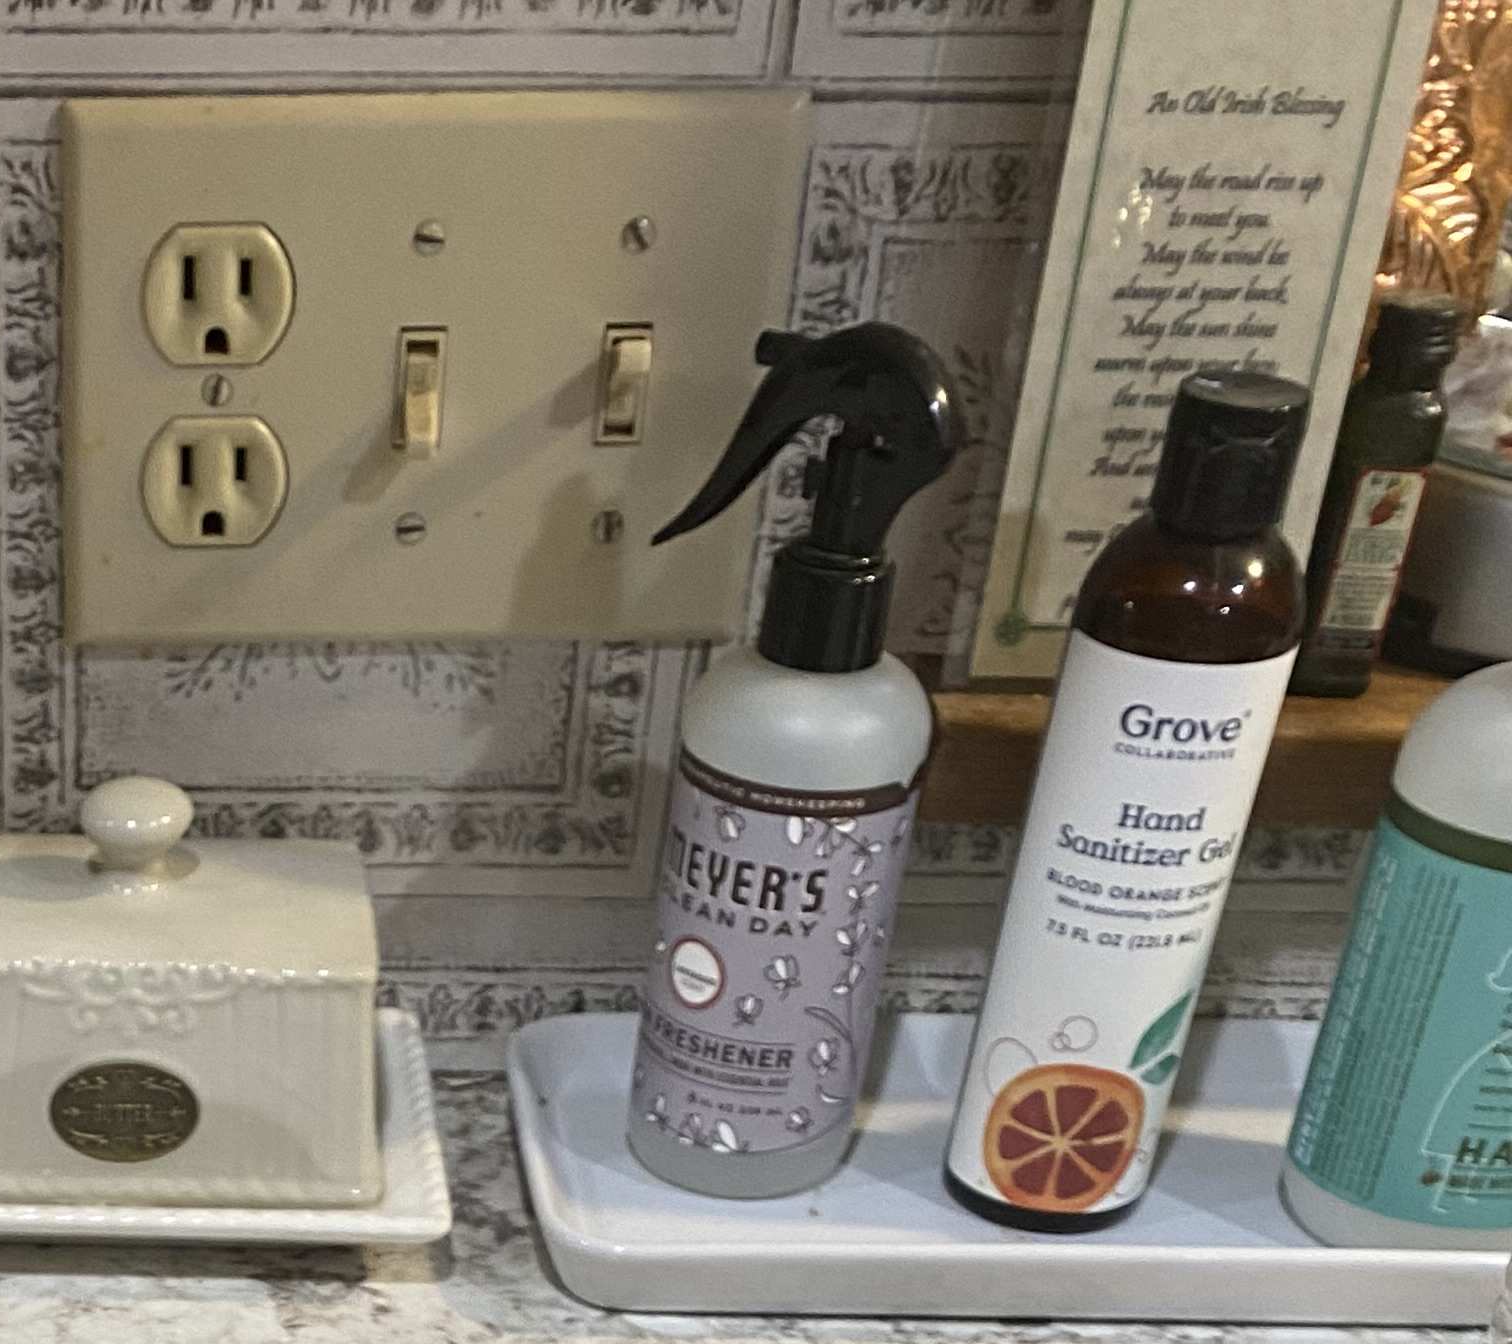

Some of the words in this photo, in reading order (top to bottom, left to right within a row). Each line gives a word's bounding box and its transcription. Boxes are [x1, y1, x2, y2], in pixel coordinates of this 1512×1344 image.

[1146, 90, 1179, 114] An
[1184, 84, 1226, 114] Old
[1221, 85, 1269, 114] Irish
[1271, 86, 1345, 129] Blessing
[1140, 166, 1186, 203] May
[1189, 162, 1217, 190] the
[1219, 163, 1271, 190] road
[1299, 173, 1324, 203] up
[1141, 241, 1186, 277] May
[1190, 237, 1218, 265] the
[1119, 312, 1167, 350] May
[1120, 703, 1243, 743] Grove
[1114, 741, 1236, 761] COLLABORATIVE
[1117, 801, 1207, 831] Hand
[1056, 822, 1191, 867] Sanitizer
[1198, 831, 1238, 863] Gel
[1046, 866, 1104, 897] BLOOD
[1108, 884, 1185, 902] ORANGE
[670, 892, 736, 928] EAN
[748, 915, 820, 938] DAY
[1069, 926, 1091, 944] FL
[1096, 931, 1124, 948] OZ
[653, 1012, 794, 1070] FRESHENER
